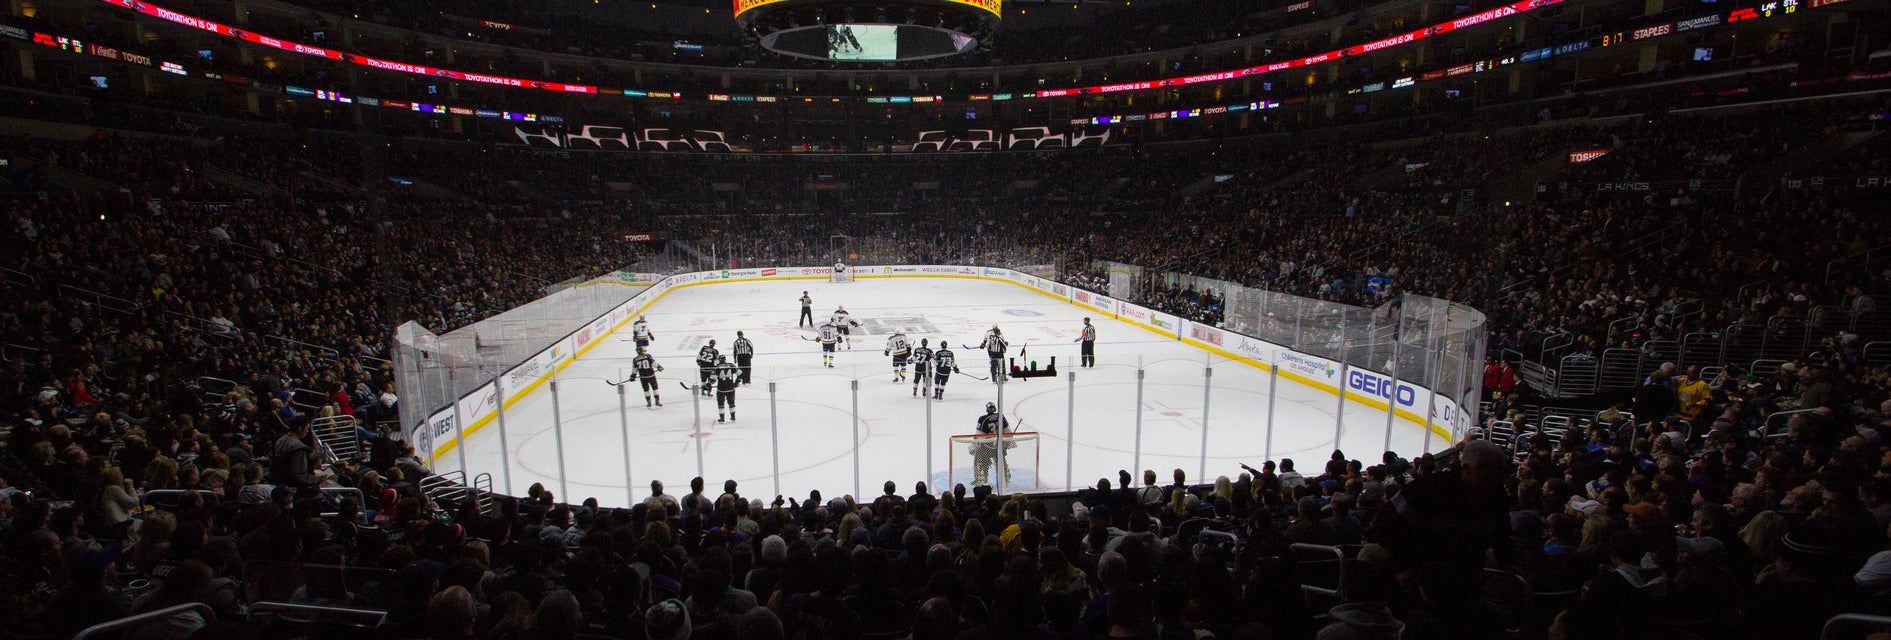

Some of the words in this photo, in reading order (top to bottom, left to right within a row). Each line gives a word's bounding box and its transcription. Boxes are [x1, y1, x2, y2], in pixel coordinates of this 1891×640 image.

[1761, 2, 1777, 11] LAK
[157, 8, 197, 26] TOYOTATHON
[198, 18, 205, 29] IS
[1453, 11, 1494, 29] TOYOTATHON
[1494, 9, 1502, 19] IS
[1633, 24, 1671, 40] STAPLES
[1363, 39, 1397, 52] TOYOTATHON
[1562, 41, 1589, 53] DELTA
[305, 47, 326, 57] TOYOTA
[122, 51, 152, 66] TOYOTA
[1311, 55, 1328, 64] TOYOTA
[366, 58, 407, 72] TOYOTATHON
[464, 73, 503, 85] TOYOTATHON
[1184, 74, 1218, 84] TOYOTATHON
[1101, 84, 1134, 92] TOYOTATHON
[1204, 106, 1227, 114] TOYOTA
[1615, 182, 1650, 191] KINGS
[680, 274, 696, 283] DELTA
[823, 331, 831, 340] 91
[895, 340, 905, 350] 12
[701, 351, 713, 363] 22
[915, 352, 927, 364] 27
[940, 356, 952, 367] 73
[719, 368, 732, 381] 44
[1349, 370, 1415, 407] GEICO
[433, 414, 454, 439] WEST
